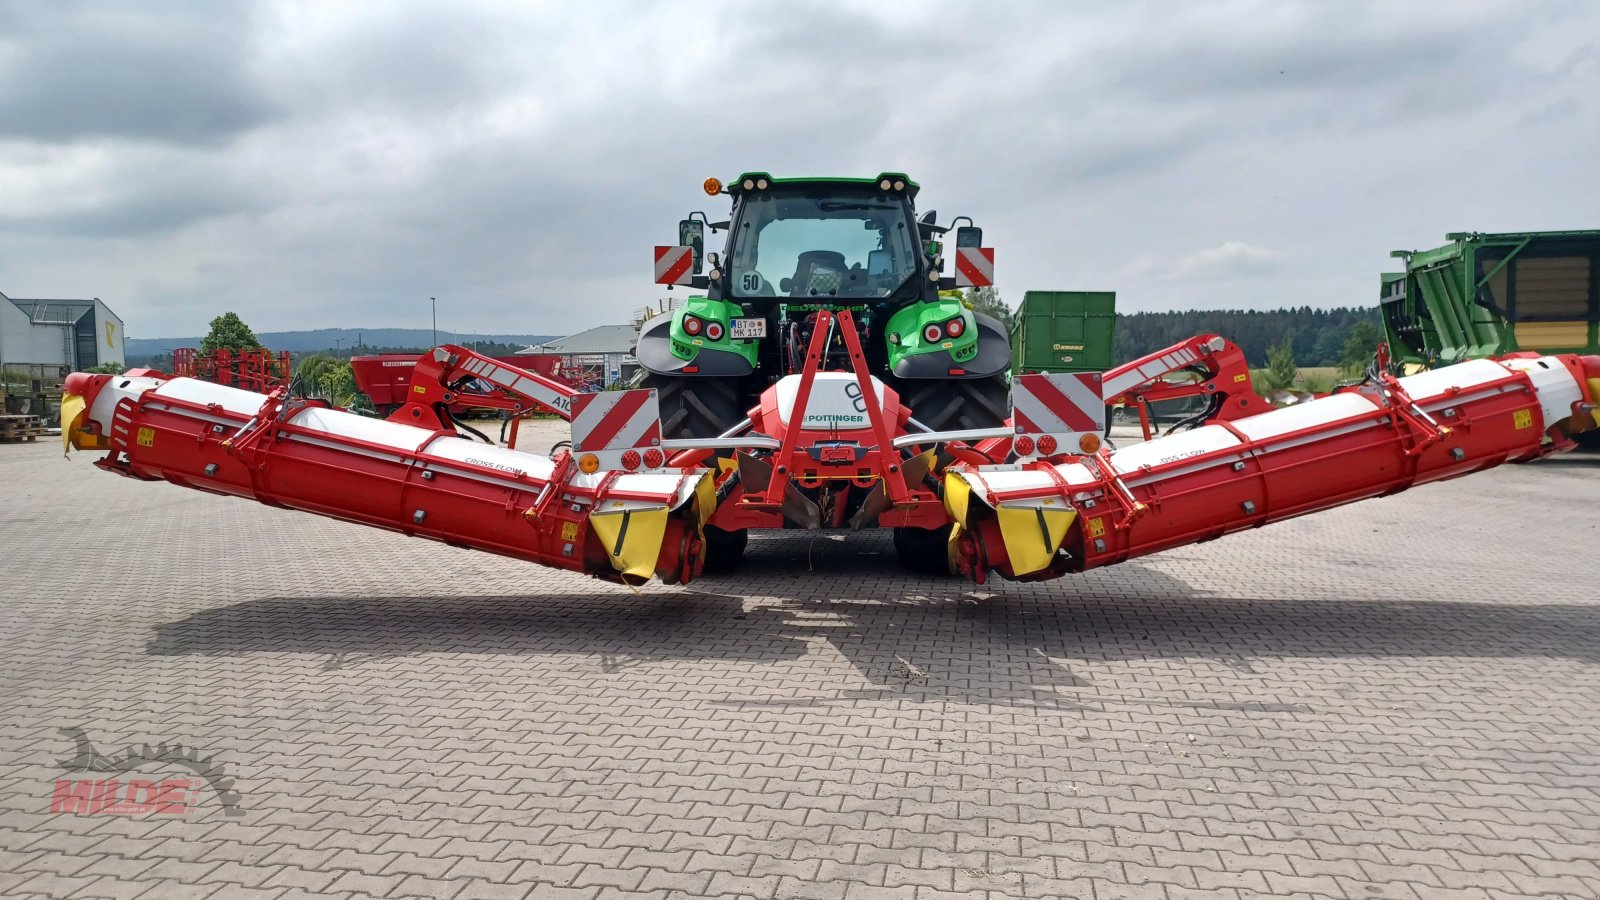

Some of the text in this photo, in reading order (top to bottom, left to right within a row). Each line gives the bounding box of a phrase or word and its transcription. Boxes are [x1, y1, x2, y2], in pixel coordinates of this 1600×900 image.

[743, 274, 759, 291] 50
[737, 320, 748, 329] BT
[733, 328, 763, 337] MK 117
[464, 457, 523, 474] CROSS FLOW
